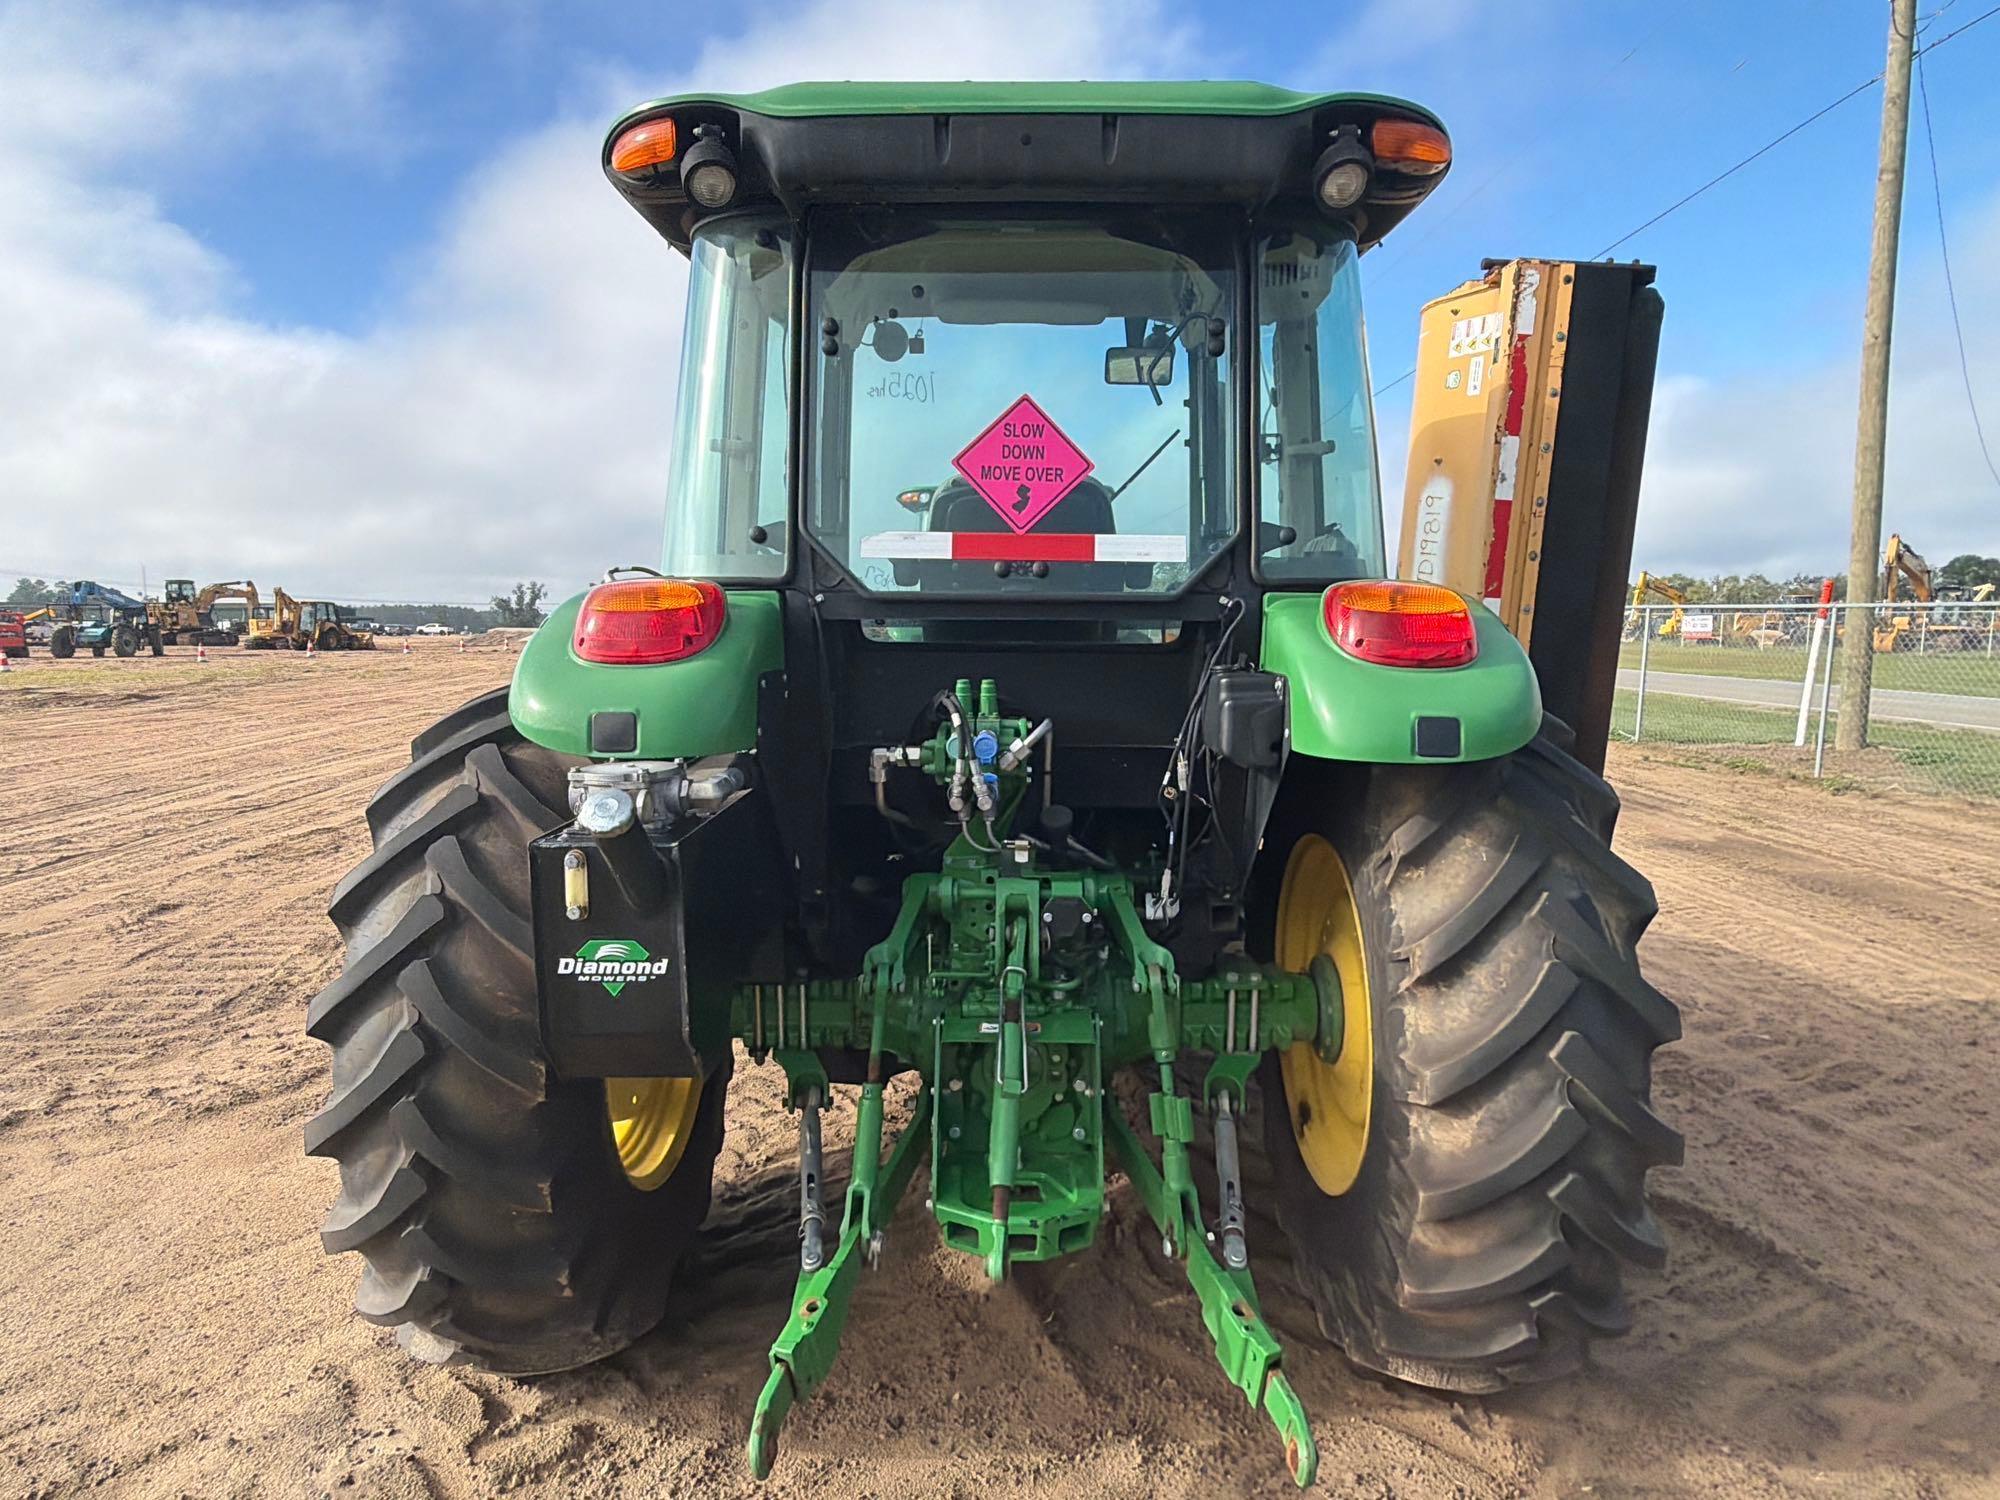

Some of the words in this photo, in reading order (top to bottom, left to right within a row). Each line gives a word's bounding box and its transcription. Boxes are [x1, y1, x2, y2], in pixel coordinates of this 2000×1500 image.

[1003, 423, 1045, 438] SLOW
[1002, 444, 1045, 460] DOWN
[980, 465, 1021, 481] MOVE
[1025, 466, 1064, 483] OVER
[557, 957, 669, 975] Diamond
